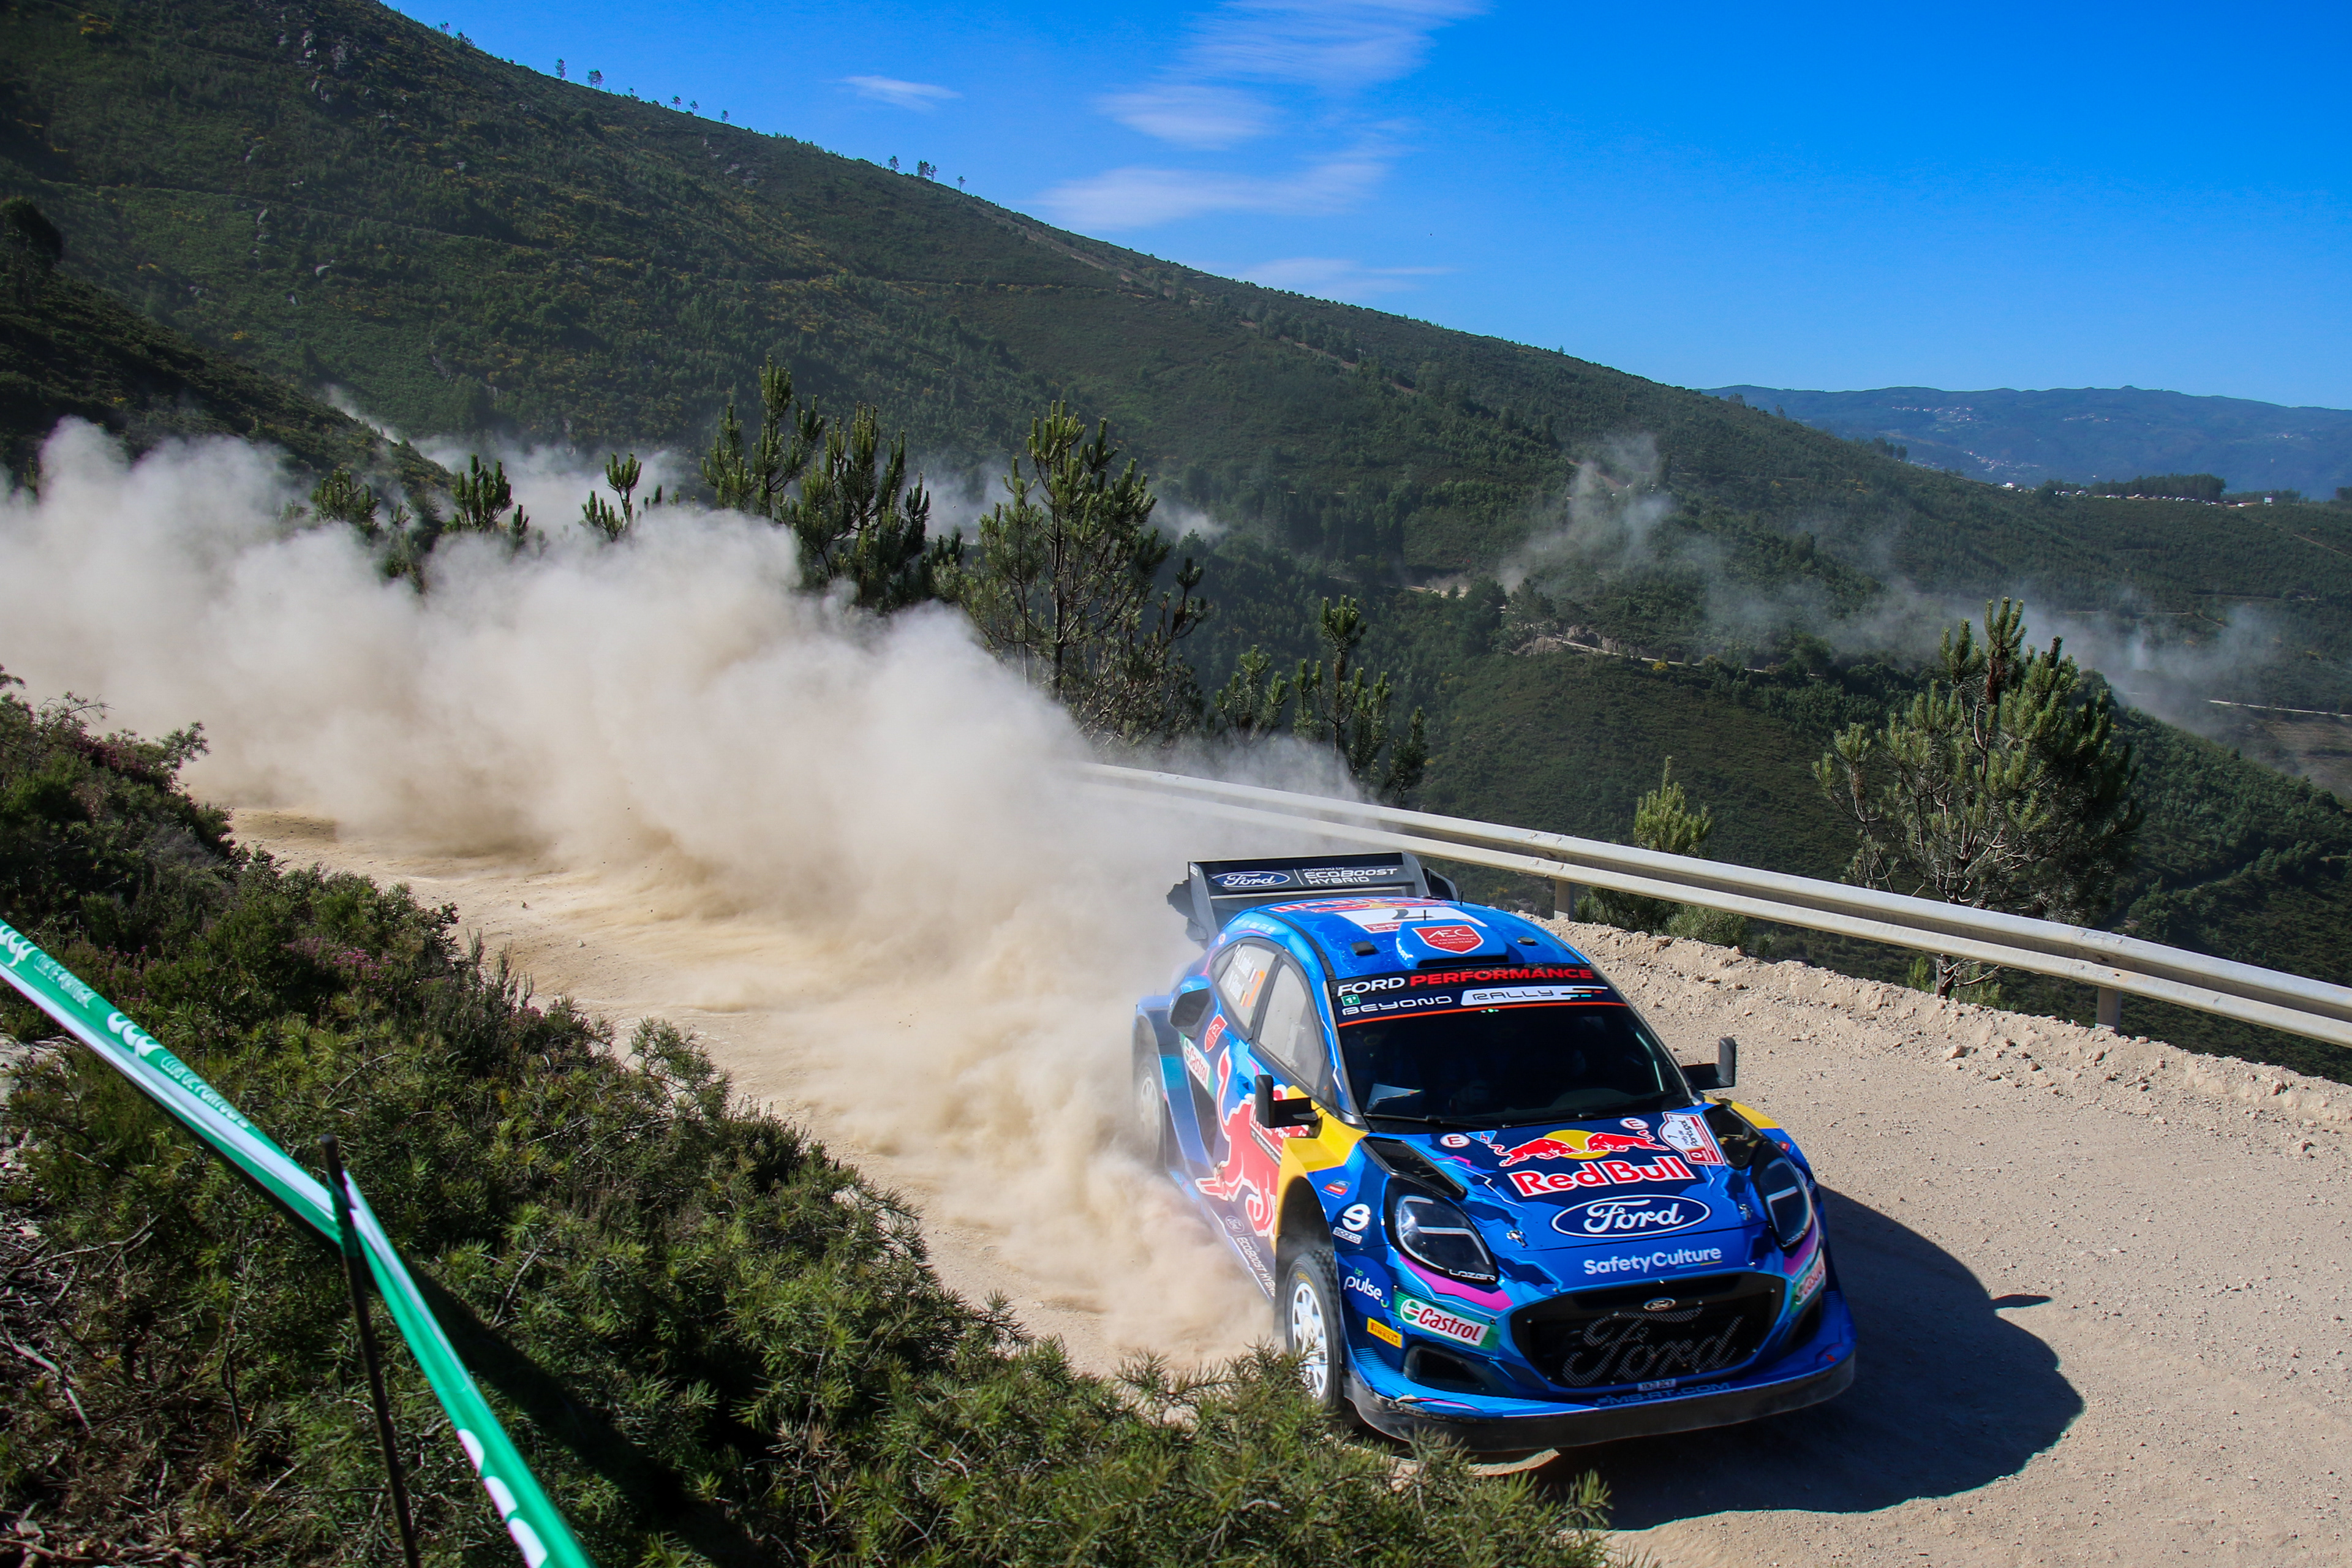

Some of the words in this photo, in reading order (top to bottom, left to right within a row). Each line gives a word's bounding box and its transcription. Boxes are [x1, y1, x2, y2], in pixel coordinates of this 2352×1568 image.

[1224, 873, 1276, 886] Ford
[1304, 868, 1398, 879] ECOBOOST
[1308, 876, 1370, 885] HYBRID
[1337, 977, 1405, 997] FORD
[1410, 968, 1594, 987] PERFORMANCE
[1341, 995, 1453, 1016] BEYOND
[1472, 989, 1555, 1001] RALLY
[1189, 1047, 1208, 1081] Castrol
[1627, 1118, 1640, 1129] E
[1447, 1135, 1461, 1146] E
[1509, 1164, 1608, 1196] Red
[1600, 1156, 1694, 1183] Bull
[1583, 1199, 1684, 1232] Ford
[1335, 1227, 1361, 1242] sparco
[1237, 1237, 1267, 1272] ECOBOOST
[1583, 1247, 1722, 1275] SafetyCulture
[1354, 1267, 1364, 1277] bp
[1448, 1268, 1496, 1281] LAZER
[1343, 1274, 1383, 1300] pulse
[1371, 1322, 1399, 1344] PIRELLI
[1419, 1308, 1482, 1342] Castrol
[1563, 1307, 1744, 1386] Ford
